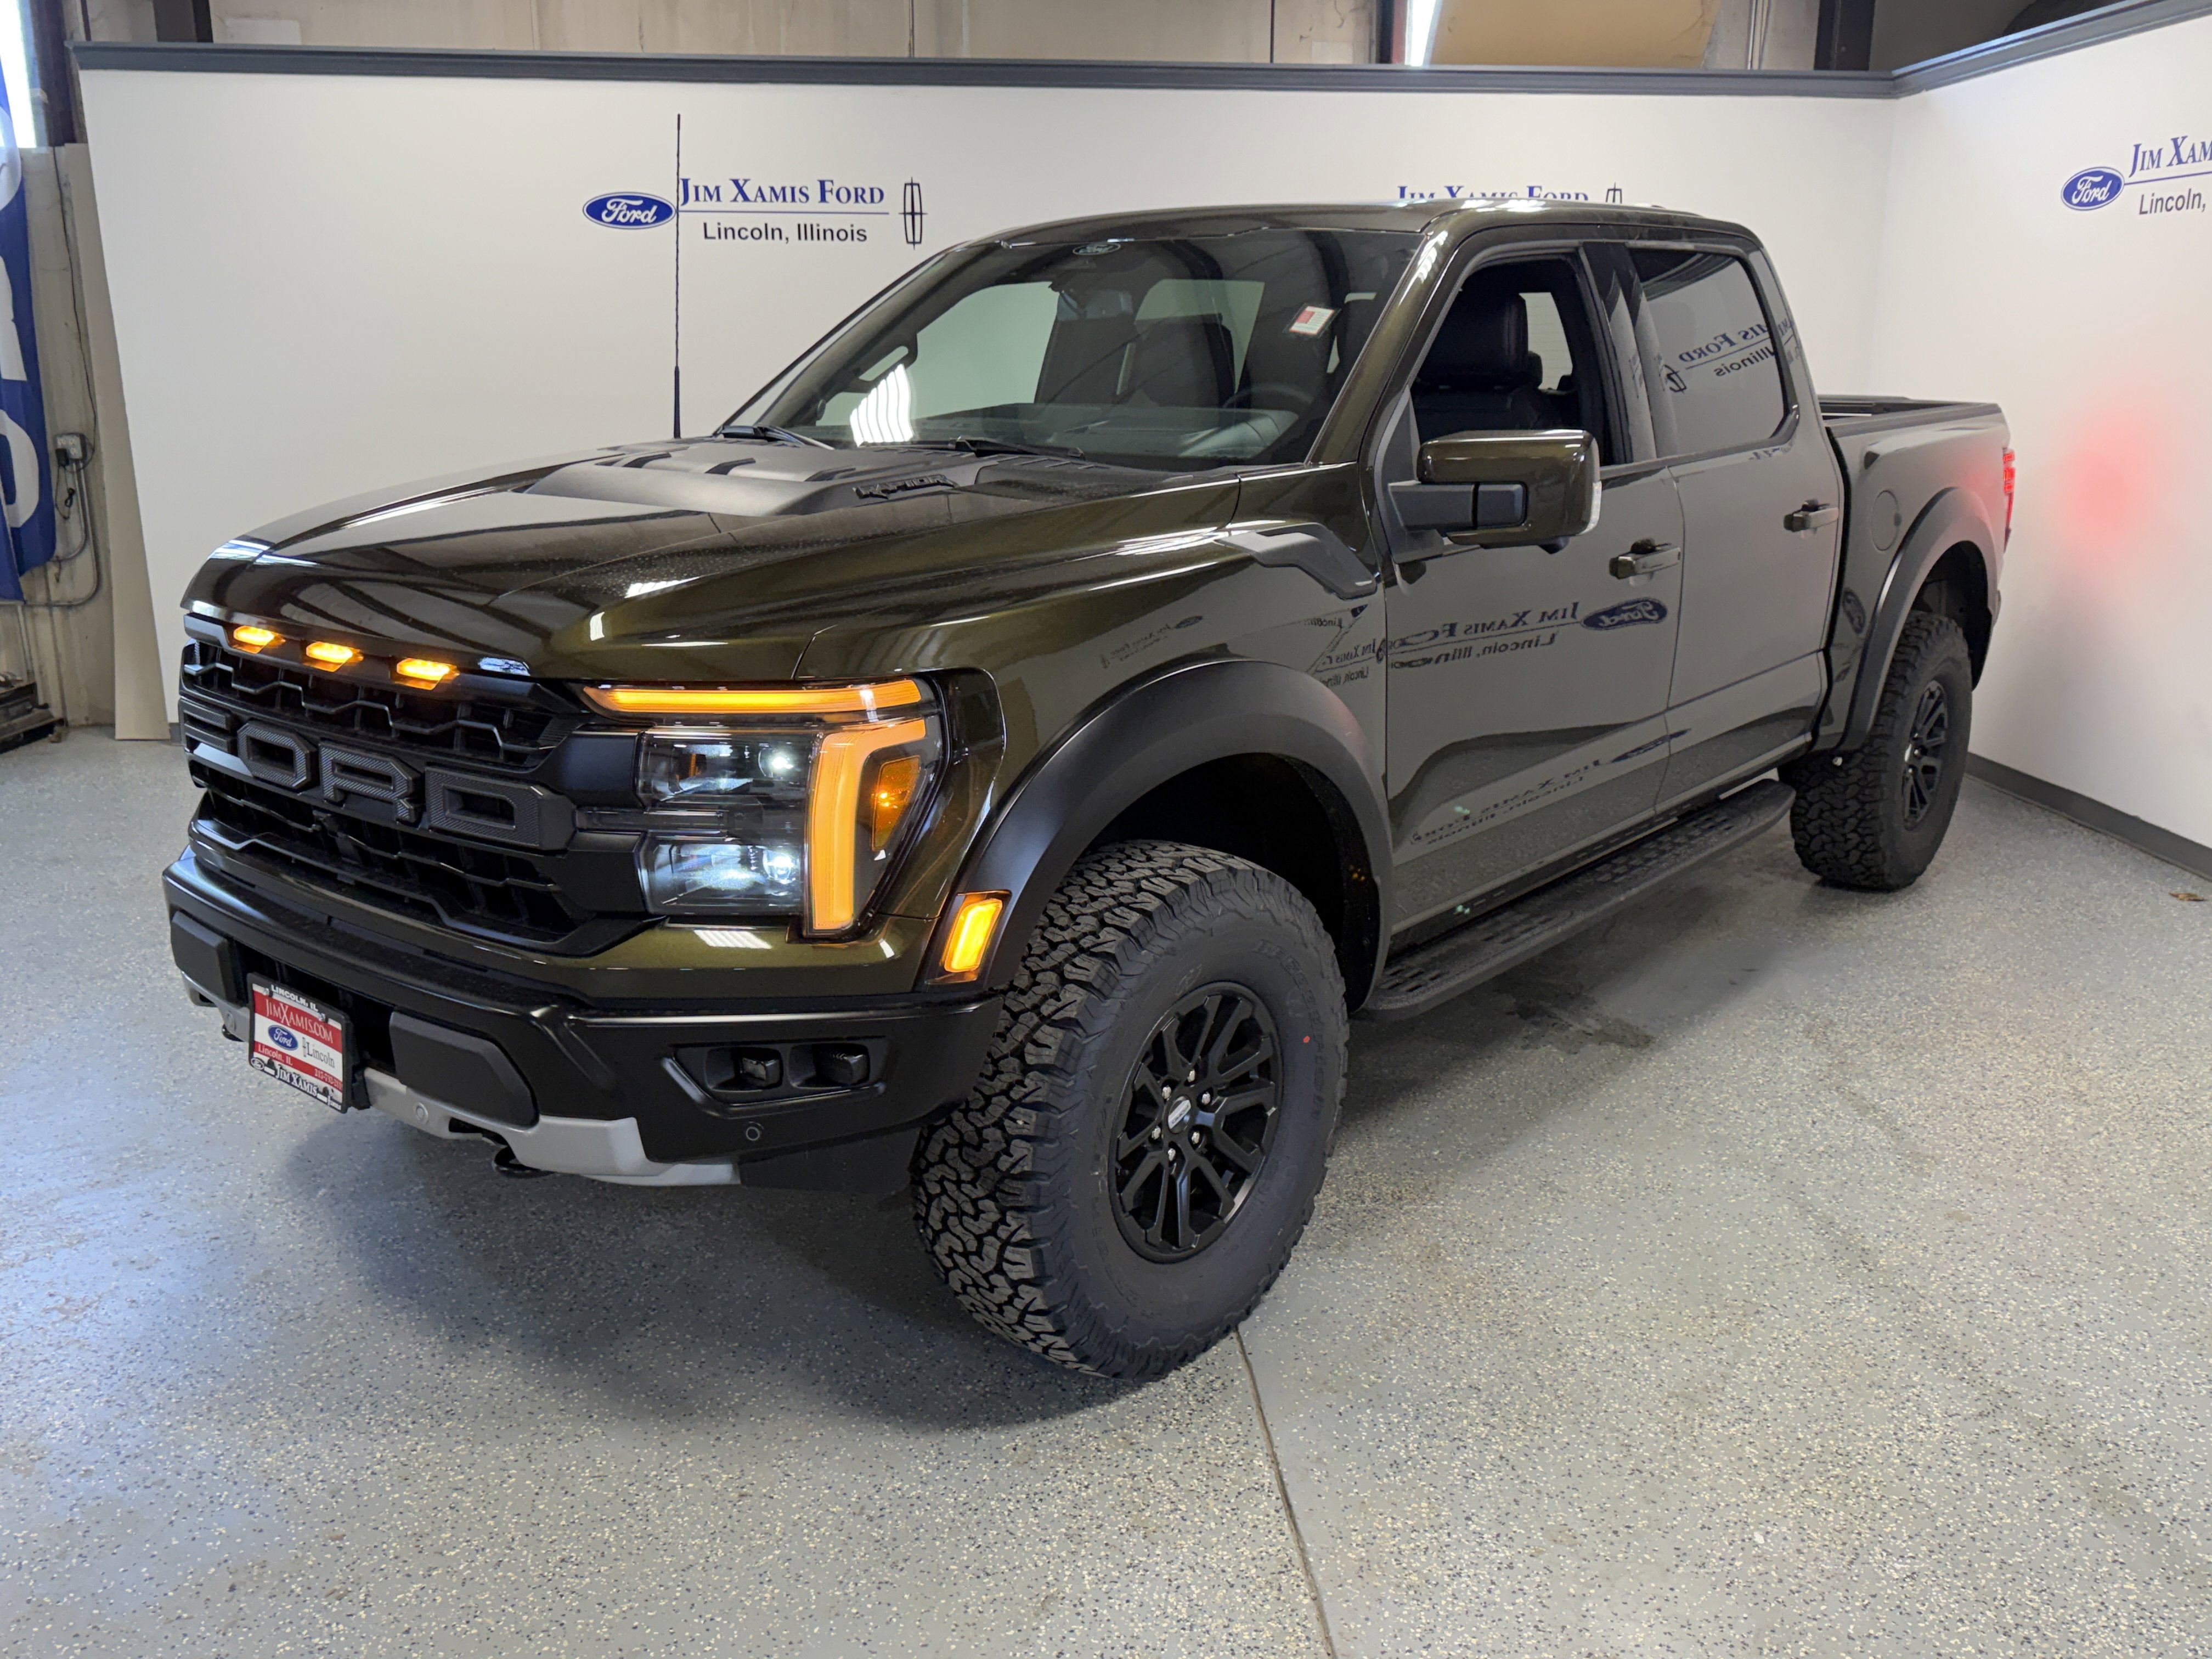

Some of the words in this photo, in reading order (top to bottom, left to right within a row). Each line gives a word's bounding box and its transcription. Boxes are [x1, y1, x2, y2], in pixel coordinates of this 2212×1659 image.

[2129, 143, 2163, 178] JIM
[680, 178, 721, 206] JIM
[729, 179, 810, 204] XAMIS
[817, 179, 884, 205] FORD
[2072, 175, 2113, 205] Ford
[2139, 188, 2206, 216] Lincoln,
[601, 198, 658, 224] Ford
[703, 223, 789, 244] Lincoln,
[798, 224, 867, 242] Illinois
[853, 473, 955, 500] RAPTOR
[274, 1028, 292, 1047] Ford
[307, 1041, 335, 1068] Lincoln
[291, 1075, 317, 1097] XAMIS
